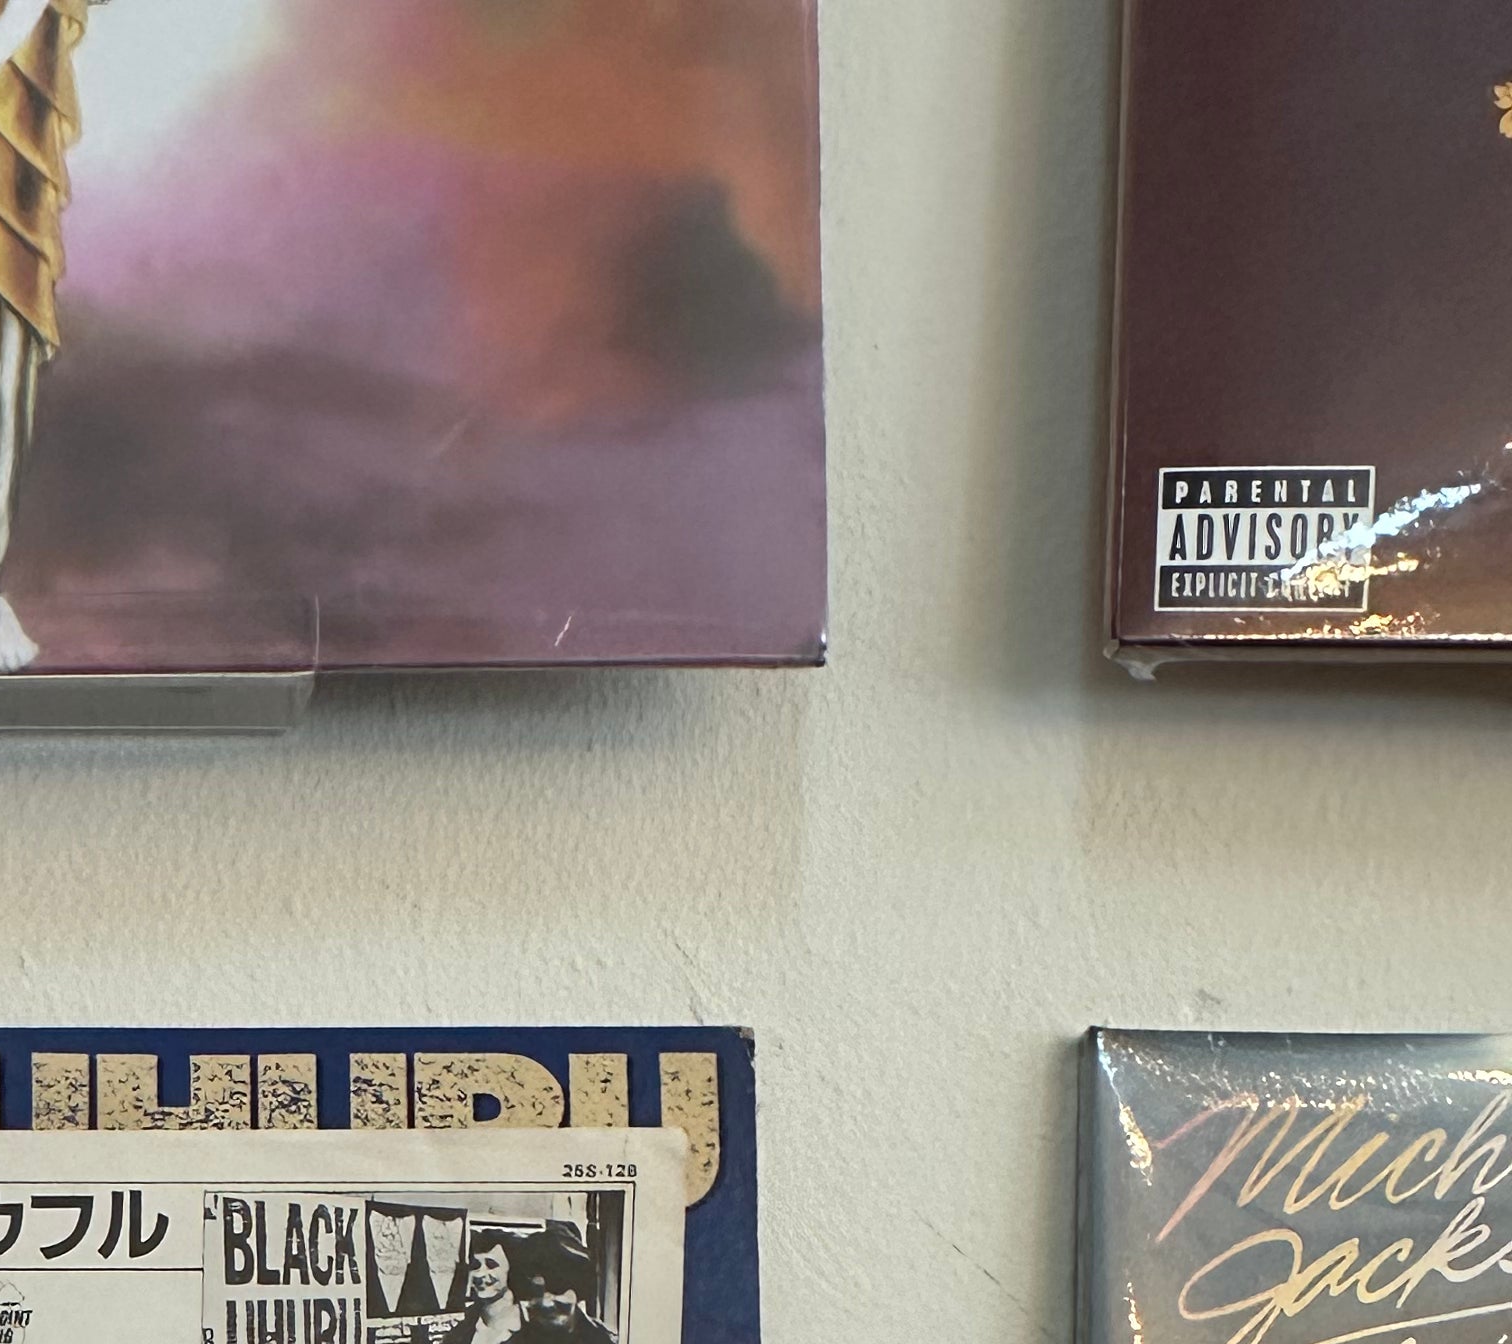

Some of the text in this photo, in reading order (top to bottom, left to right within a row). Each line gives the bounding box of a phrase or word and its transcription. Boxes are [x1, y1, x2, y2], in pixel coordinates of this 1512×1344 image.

[1175, 479, 1356, 503] PARENTAL
[1171, 572, 1258, 599] EXPLICIT
[223, 1197, 361, 1286] BLACK
